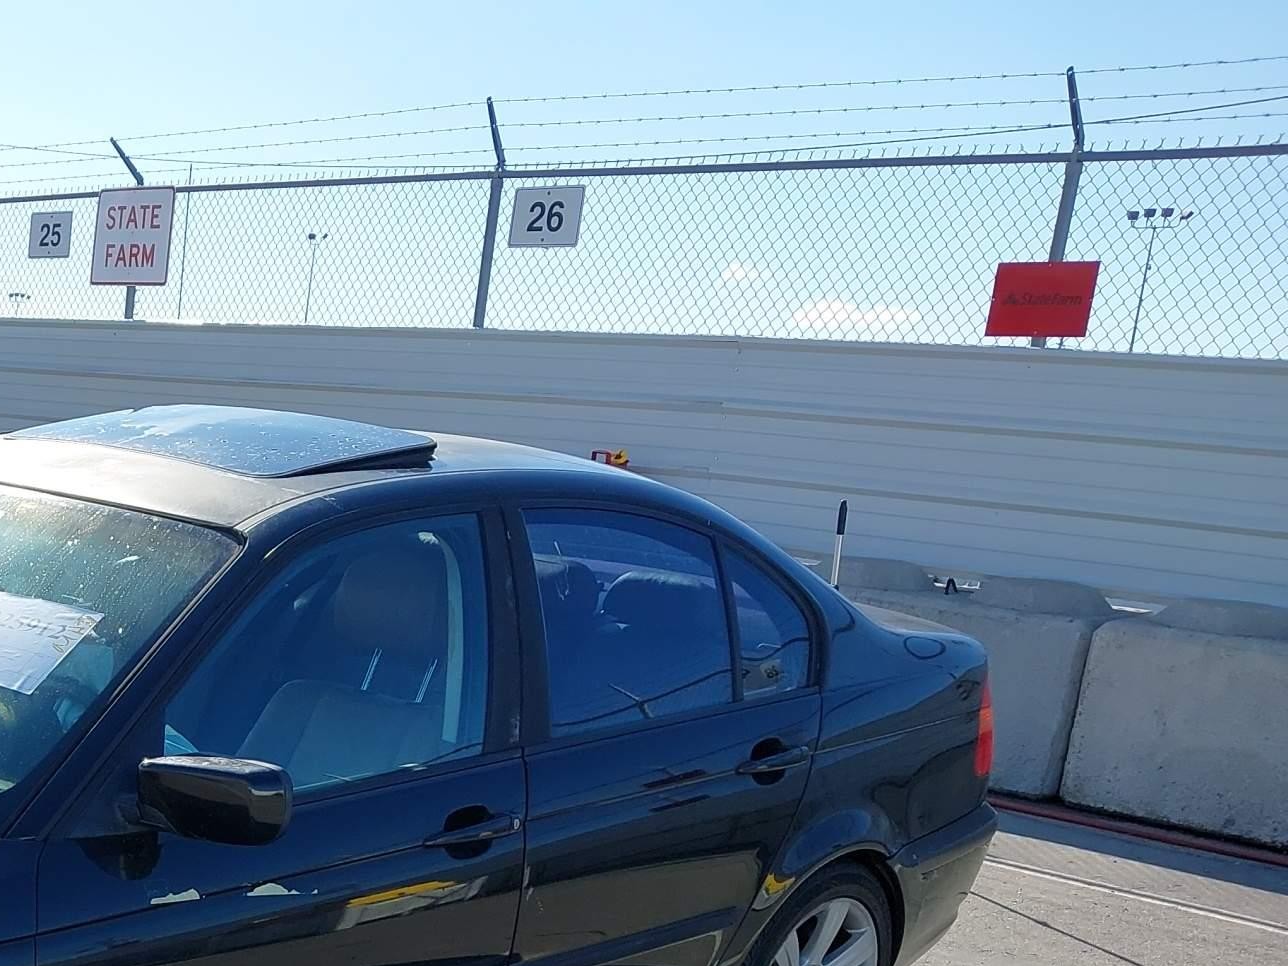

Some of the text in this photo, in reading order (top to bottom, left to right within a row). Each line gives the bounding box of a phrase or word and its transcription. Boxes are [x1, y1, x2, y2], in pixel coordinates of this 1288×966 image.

[105, 204, 162, 230] STATE
[526, 200, 565, 233] 26
[39, 223, 61, 247] 25
[104, 243, 154, 268] FARM
